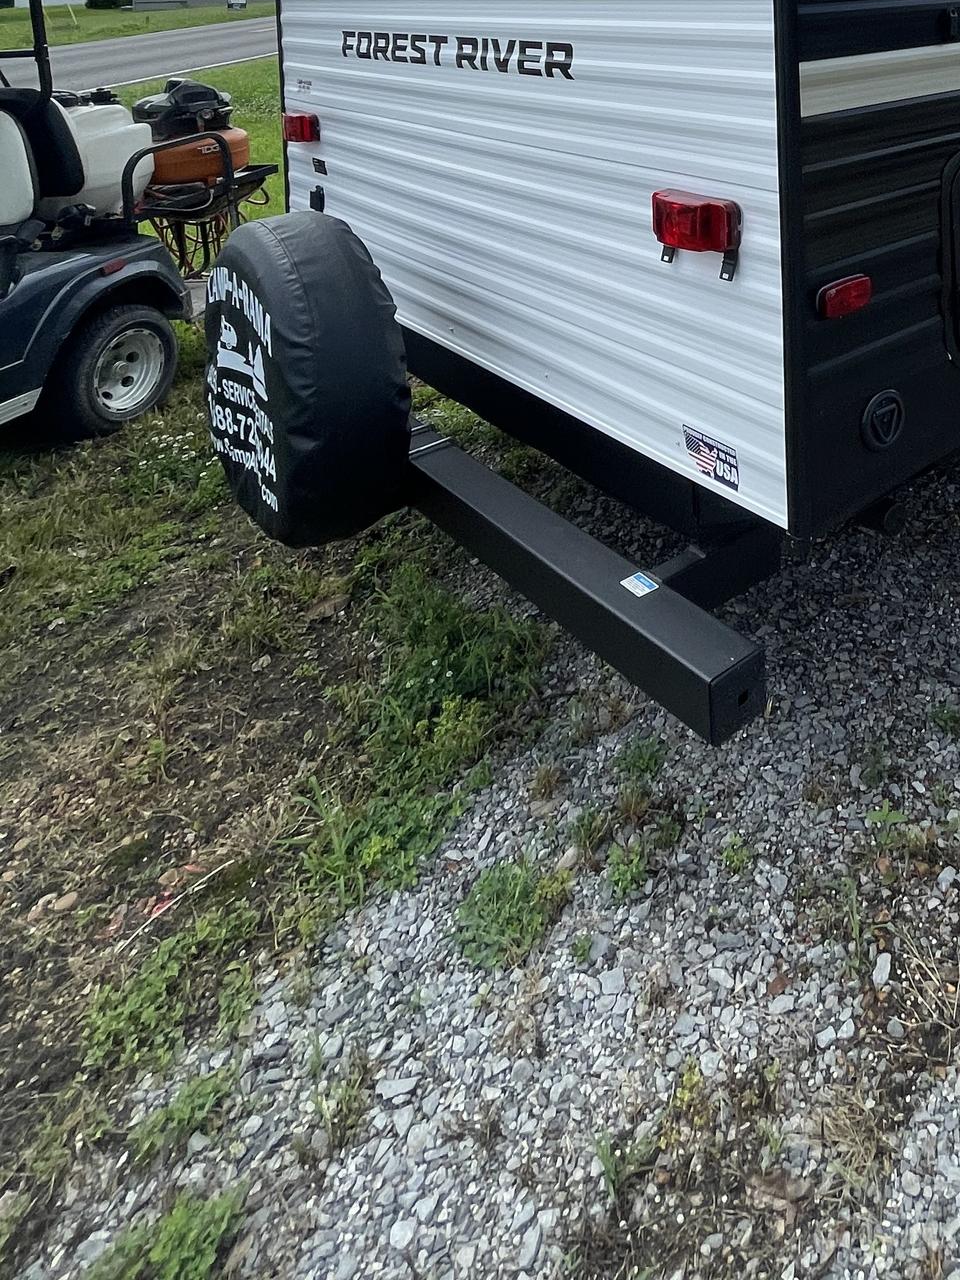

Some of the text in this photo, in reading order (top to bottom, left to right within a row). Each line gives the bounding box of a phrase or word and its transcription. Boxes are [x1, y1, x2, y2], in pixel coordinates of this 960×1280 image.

[341, 30, 575, 81] FOREST RIVER
[716, 459, 739, 485] USA
